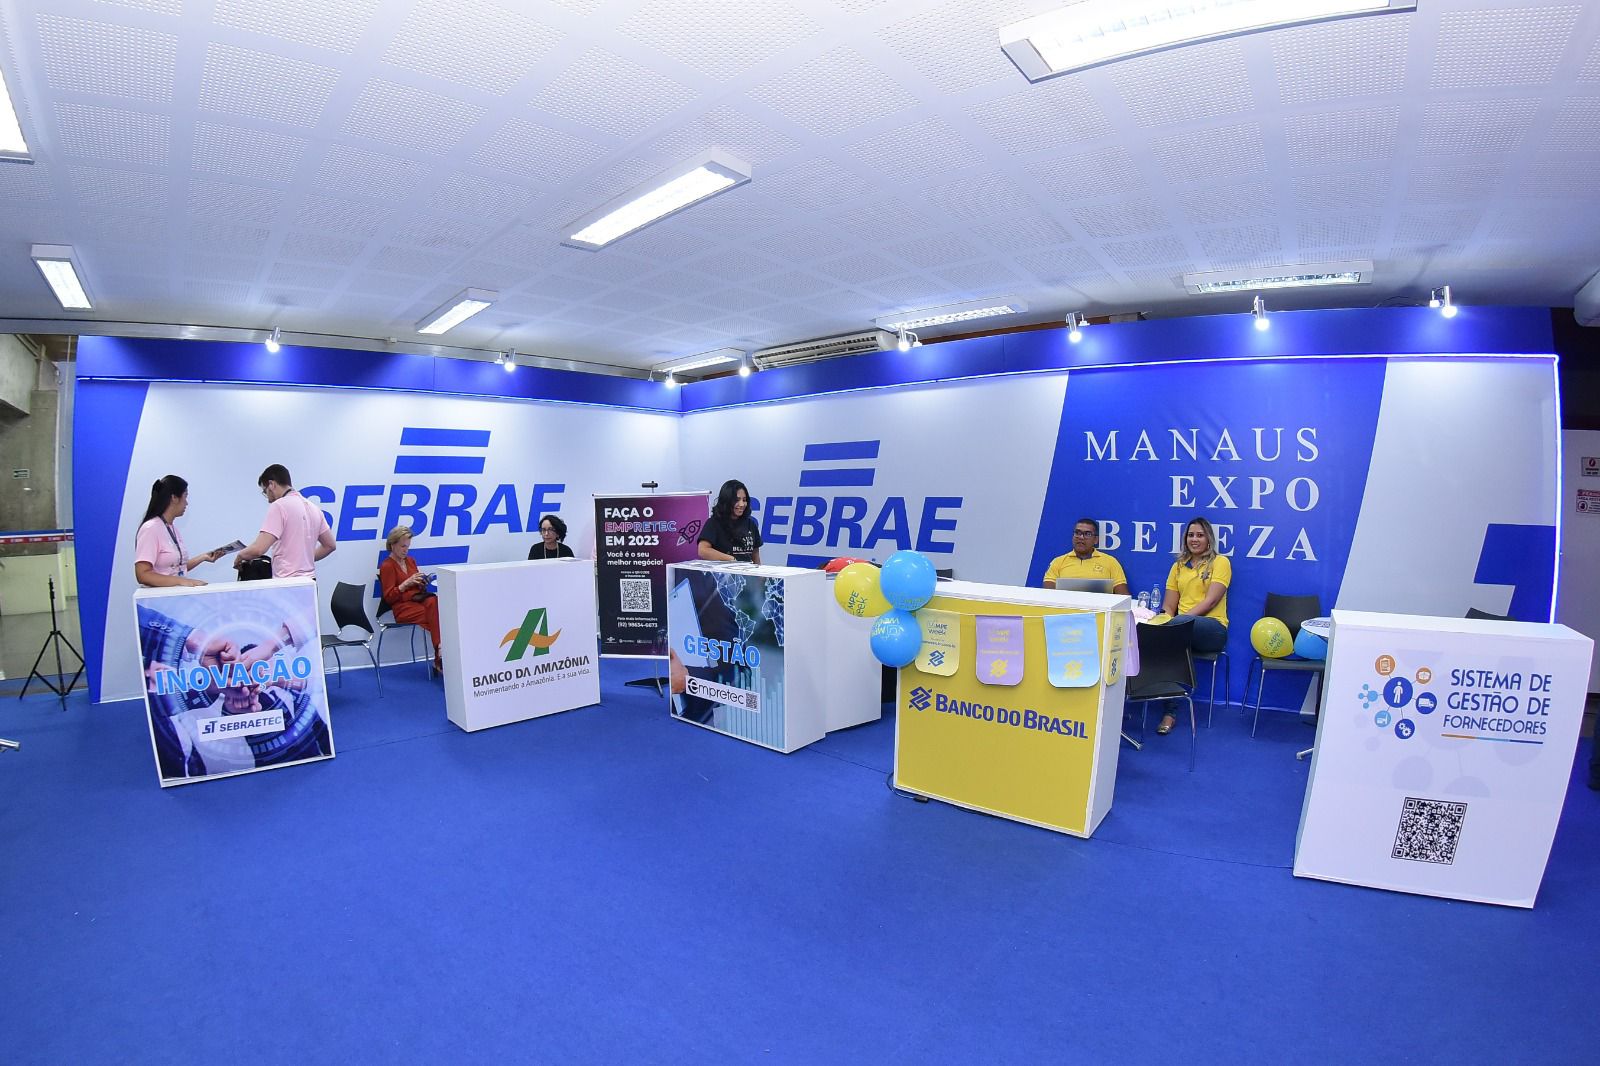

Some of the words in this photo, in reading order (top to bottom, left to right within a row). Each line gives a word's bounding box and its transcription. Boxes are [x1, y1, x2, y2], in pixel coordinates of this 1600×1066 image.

[1083, 427, 1319, 462] MANAUS
[1168, 475, 1320, 512] EXPO
[604, 507, 640, 520] FAÇA
[643, 506, 654, 517] O
[604, 520, 677, 532] EMPRETEC
[605, 535, 625, 546] EM
[628, 535, 660, 546] 2023
[1095, 519, 1319, 562] BELEZA
[633, 559, 664, 567] negócio!
[683, 634, 761, 669] GESTÃO
[155, 653, 312, 696] INOVAÇÃO
[472, 670, 513, 688] BANCO
[515, 666, 531, 679] DA
[534, 655, 590, 676] AMAZÔNIA
[1450, 668, 1522, 691] SISTEMA
[1529, 673, 1553, 693] DE
[473, 682, 520, 698] Movimentando
[687, 677, 745, 705] empretec
[1447, 691, 1519, 714] GESTÃO
[1526, 697, 1551, 716] DE
[219, 716, 283, 733] SEBRAETEC
[935, 693, 994, 722] BANCO
[997, 707, 1021, 727] DO
[1023, 709, 1089, 740] BRASIL
[1443, 714, 1547, 735] FORNECEDORES
